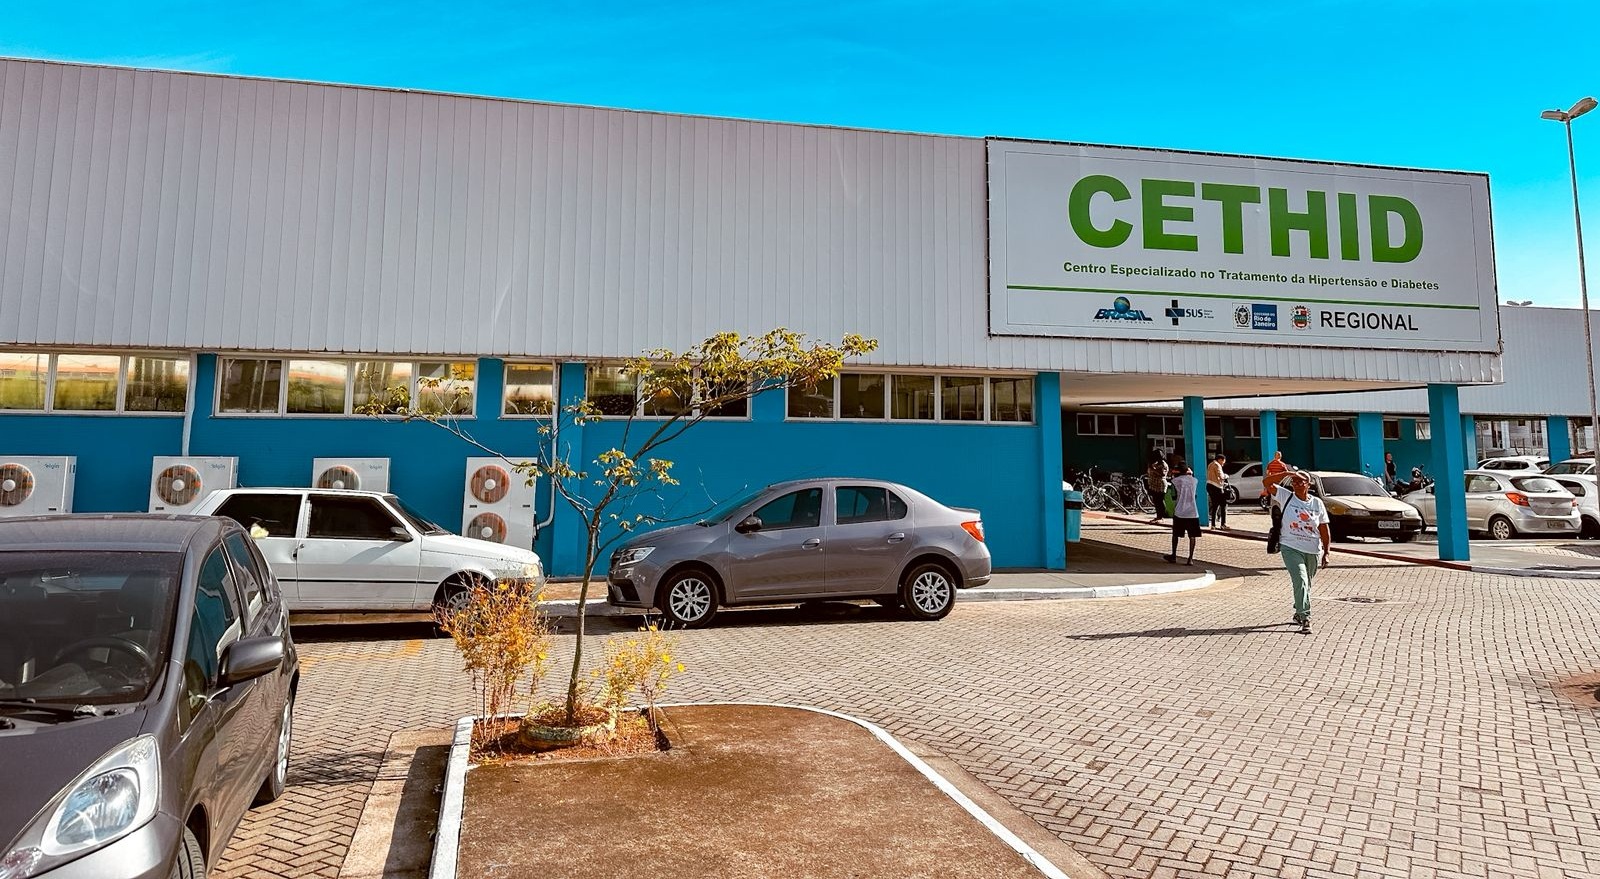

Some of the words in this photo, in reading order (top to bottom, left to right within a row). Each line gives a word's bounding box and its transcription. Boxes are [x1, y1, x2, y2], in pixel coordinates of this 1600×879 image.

[1068, 174, 1424, 264] CETHID
[1063, 262, 1106, 274] Centro
[1110, 264, 1196, 278] Especializado
[1200, 271, 1215, 279] no
[1219, 270, 1288, 283] Tratamento
[1291, 274, 1305, 284] da
[1308, 275, 1378, 288] Hipertensão
[1381, 280, 1388, 288] e
[1391, 279, 1439, 290] Diabetes
[1093, 308, 1153, 321] BRASIL
[1185, 308, 1203, 318] SUS
[1320, 311, 1419, 331] REGIONAL
